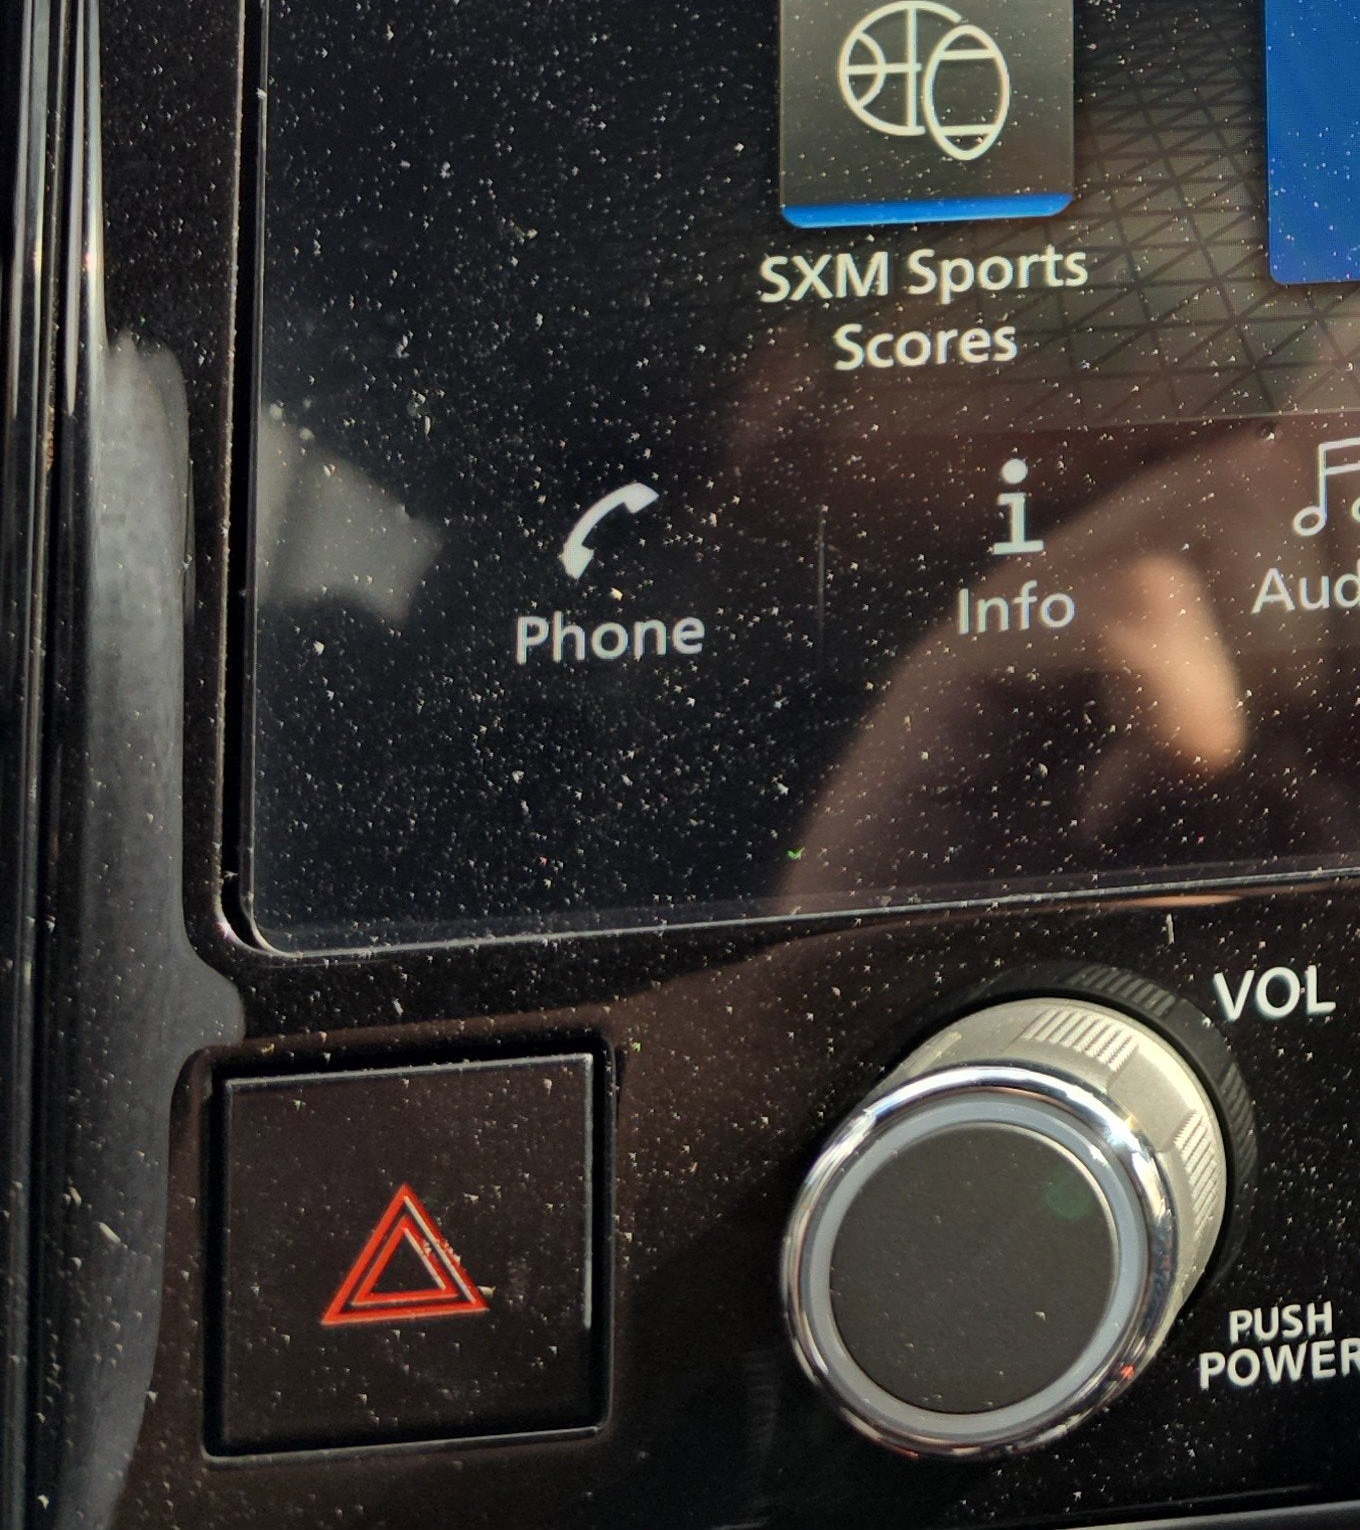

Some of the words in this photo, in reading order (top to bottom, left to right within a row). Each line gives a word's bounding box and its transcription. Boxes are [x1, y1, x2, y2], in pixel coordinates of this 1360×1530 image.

[761, 252, 888, 302] SXM
[908, 245, 1088, 304] Sports
[834, 324, 1017, 370] Scores
[959, 581, 1074, 634] Info
[517, 611, 704, 664] Phone
[1214, 965, 1336, 1021] VOL
[1231, 1302, 1333, 1343] PUSH
